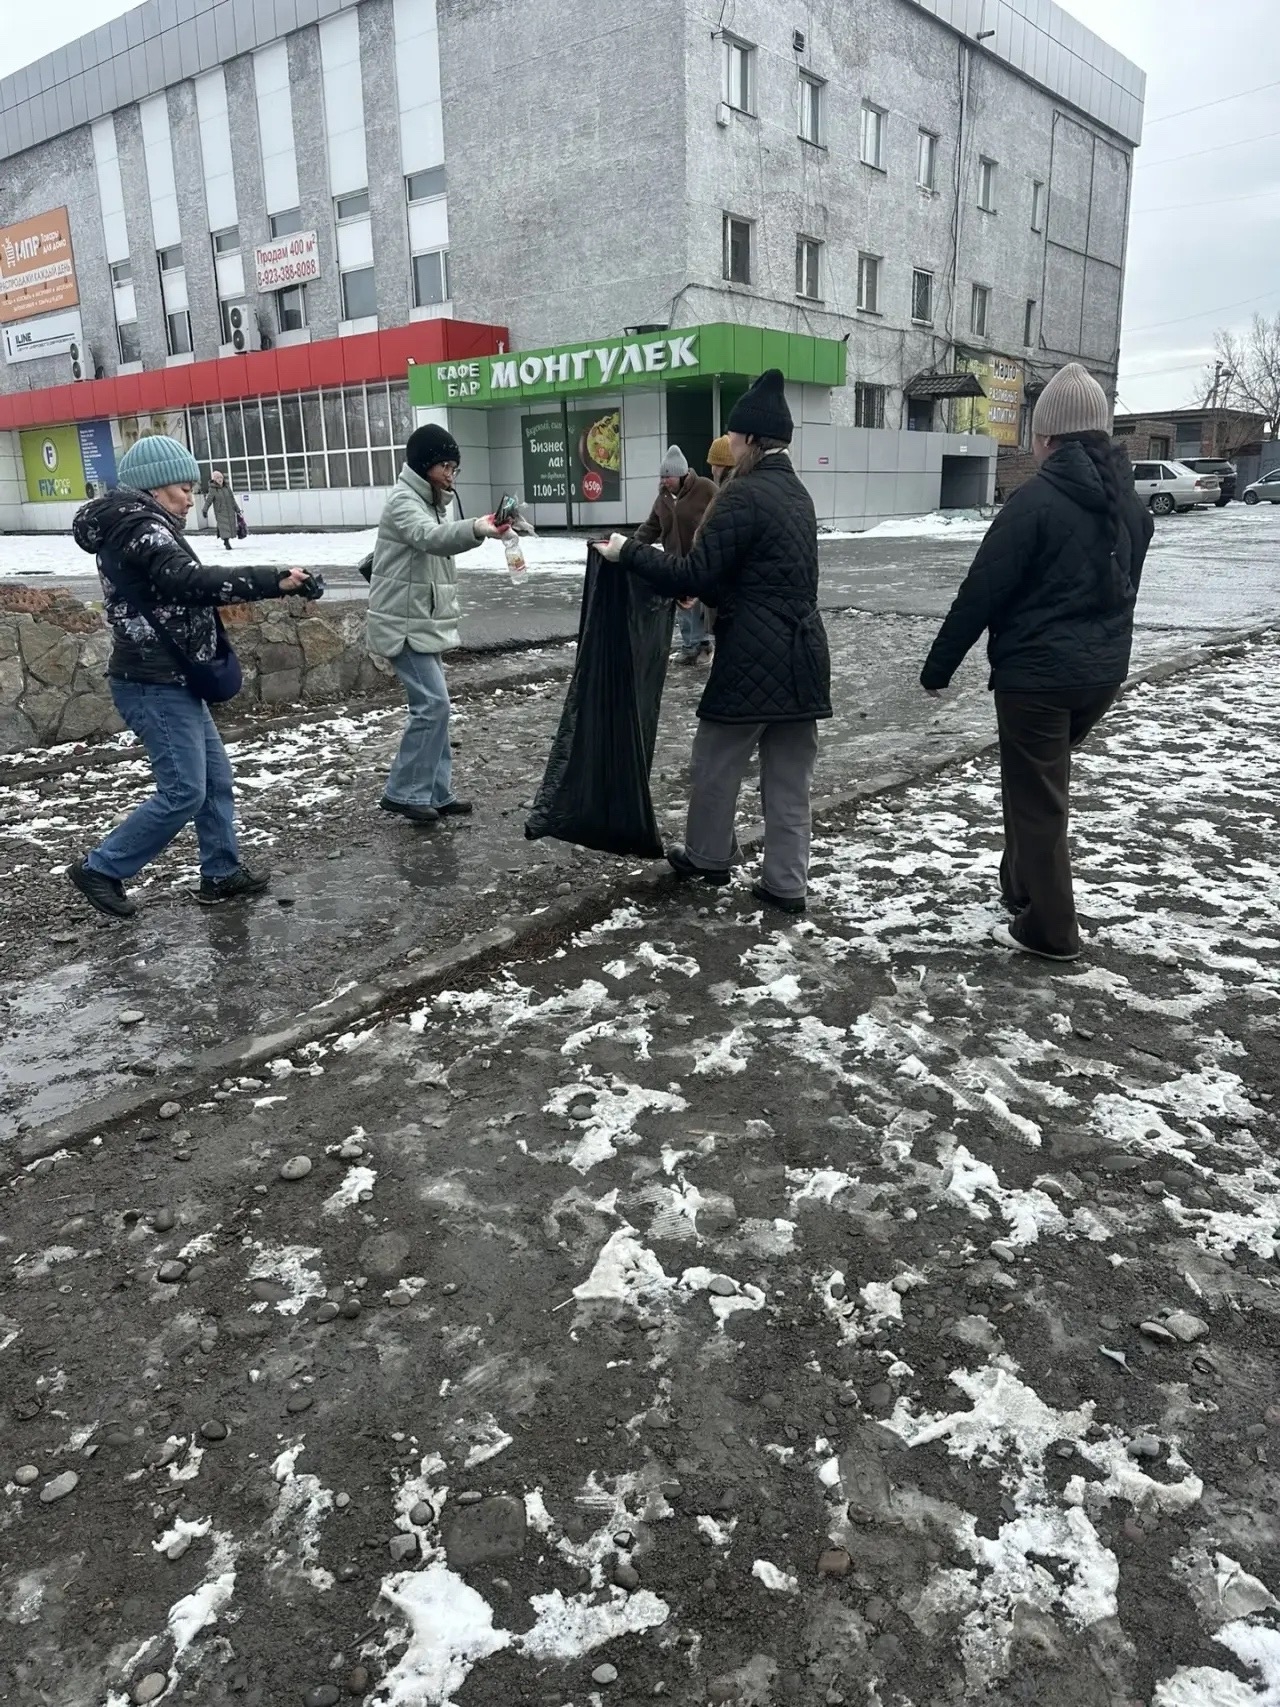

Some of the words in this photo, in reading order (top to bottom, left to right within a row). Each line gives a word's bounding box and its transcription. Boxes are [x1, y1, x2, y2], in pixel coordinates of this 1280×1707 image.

[256, 246, 289, 266] Продам
[289, 239, 304, 256] 400
[490, 333, 699, 389] МОНГУЛЕК
[437, 363, 480, 380] КАФЕ
[447, 381, 481, 397] БАР
[530, 439, 564, 453] Бизнес
[38, 479, 57, 497] FIX
